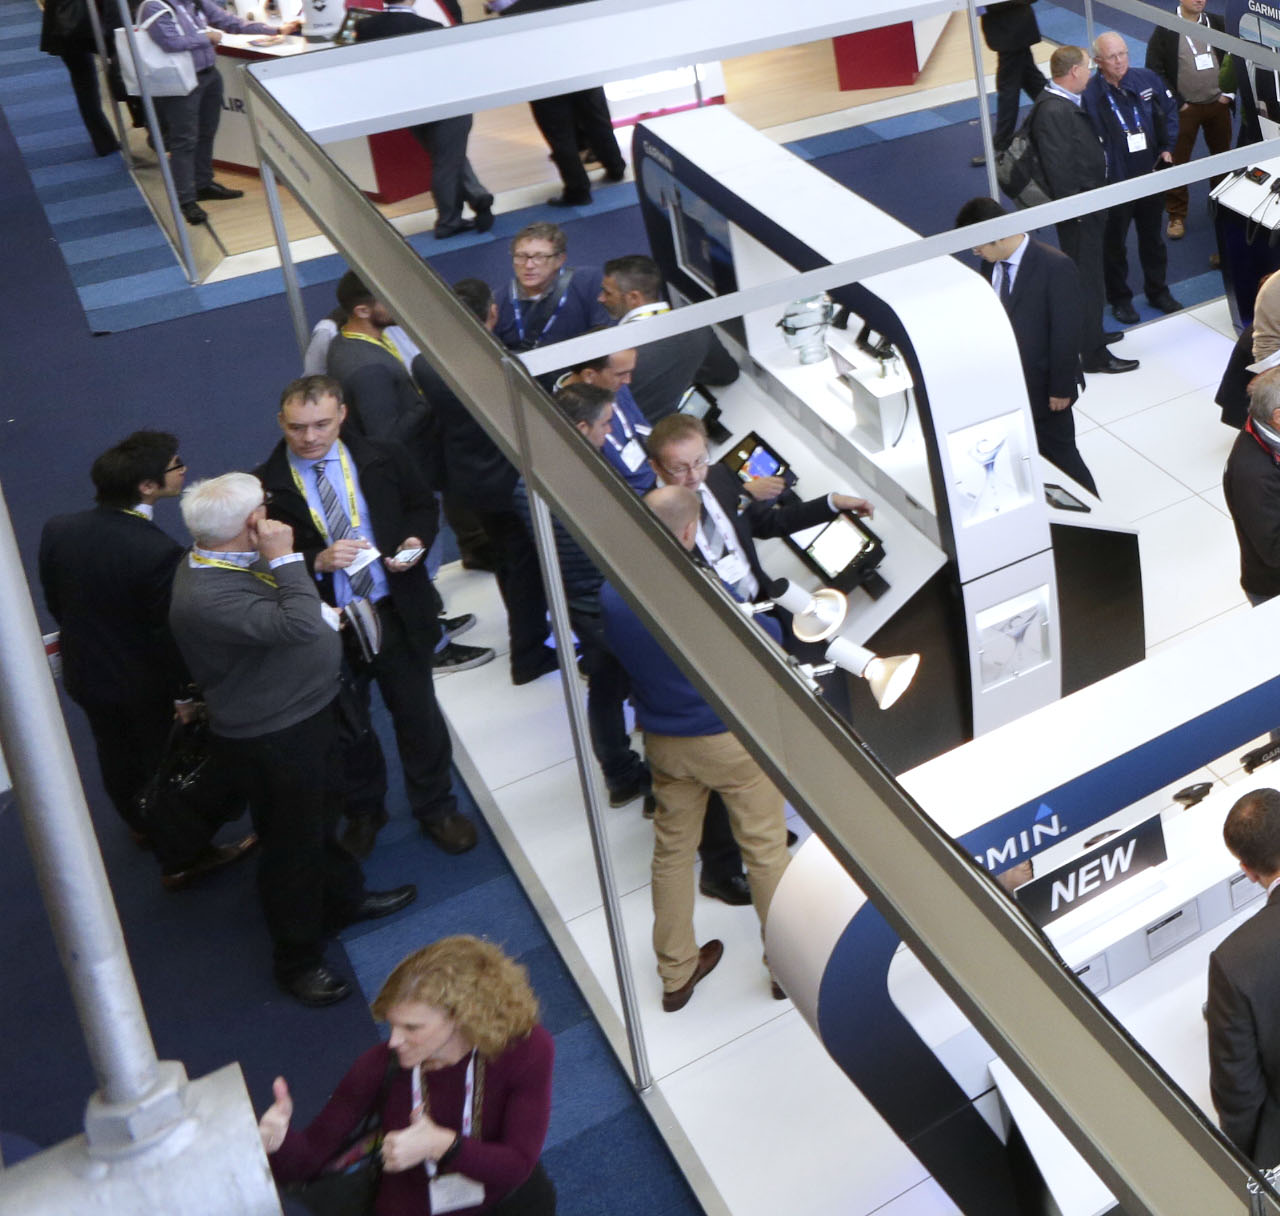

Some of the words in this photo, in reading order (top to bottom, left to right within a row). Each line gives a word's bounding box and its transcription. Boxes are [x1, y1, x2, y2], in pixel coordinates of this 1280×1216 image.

[222, 97, 246, 114] LIR
[974, 814, 1061, 872] MIN
[1050, 839, 1137, 912] NEW
